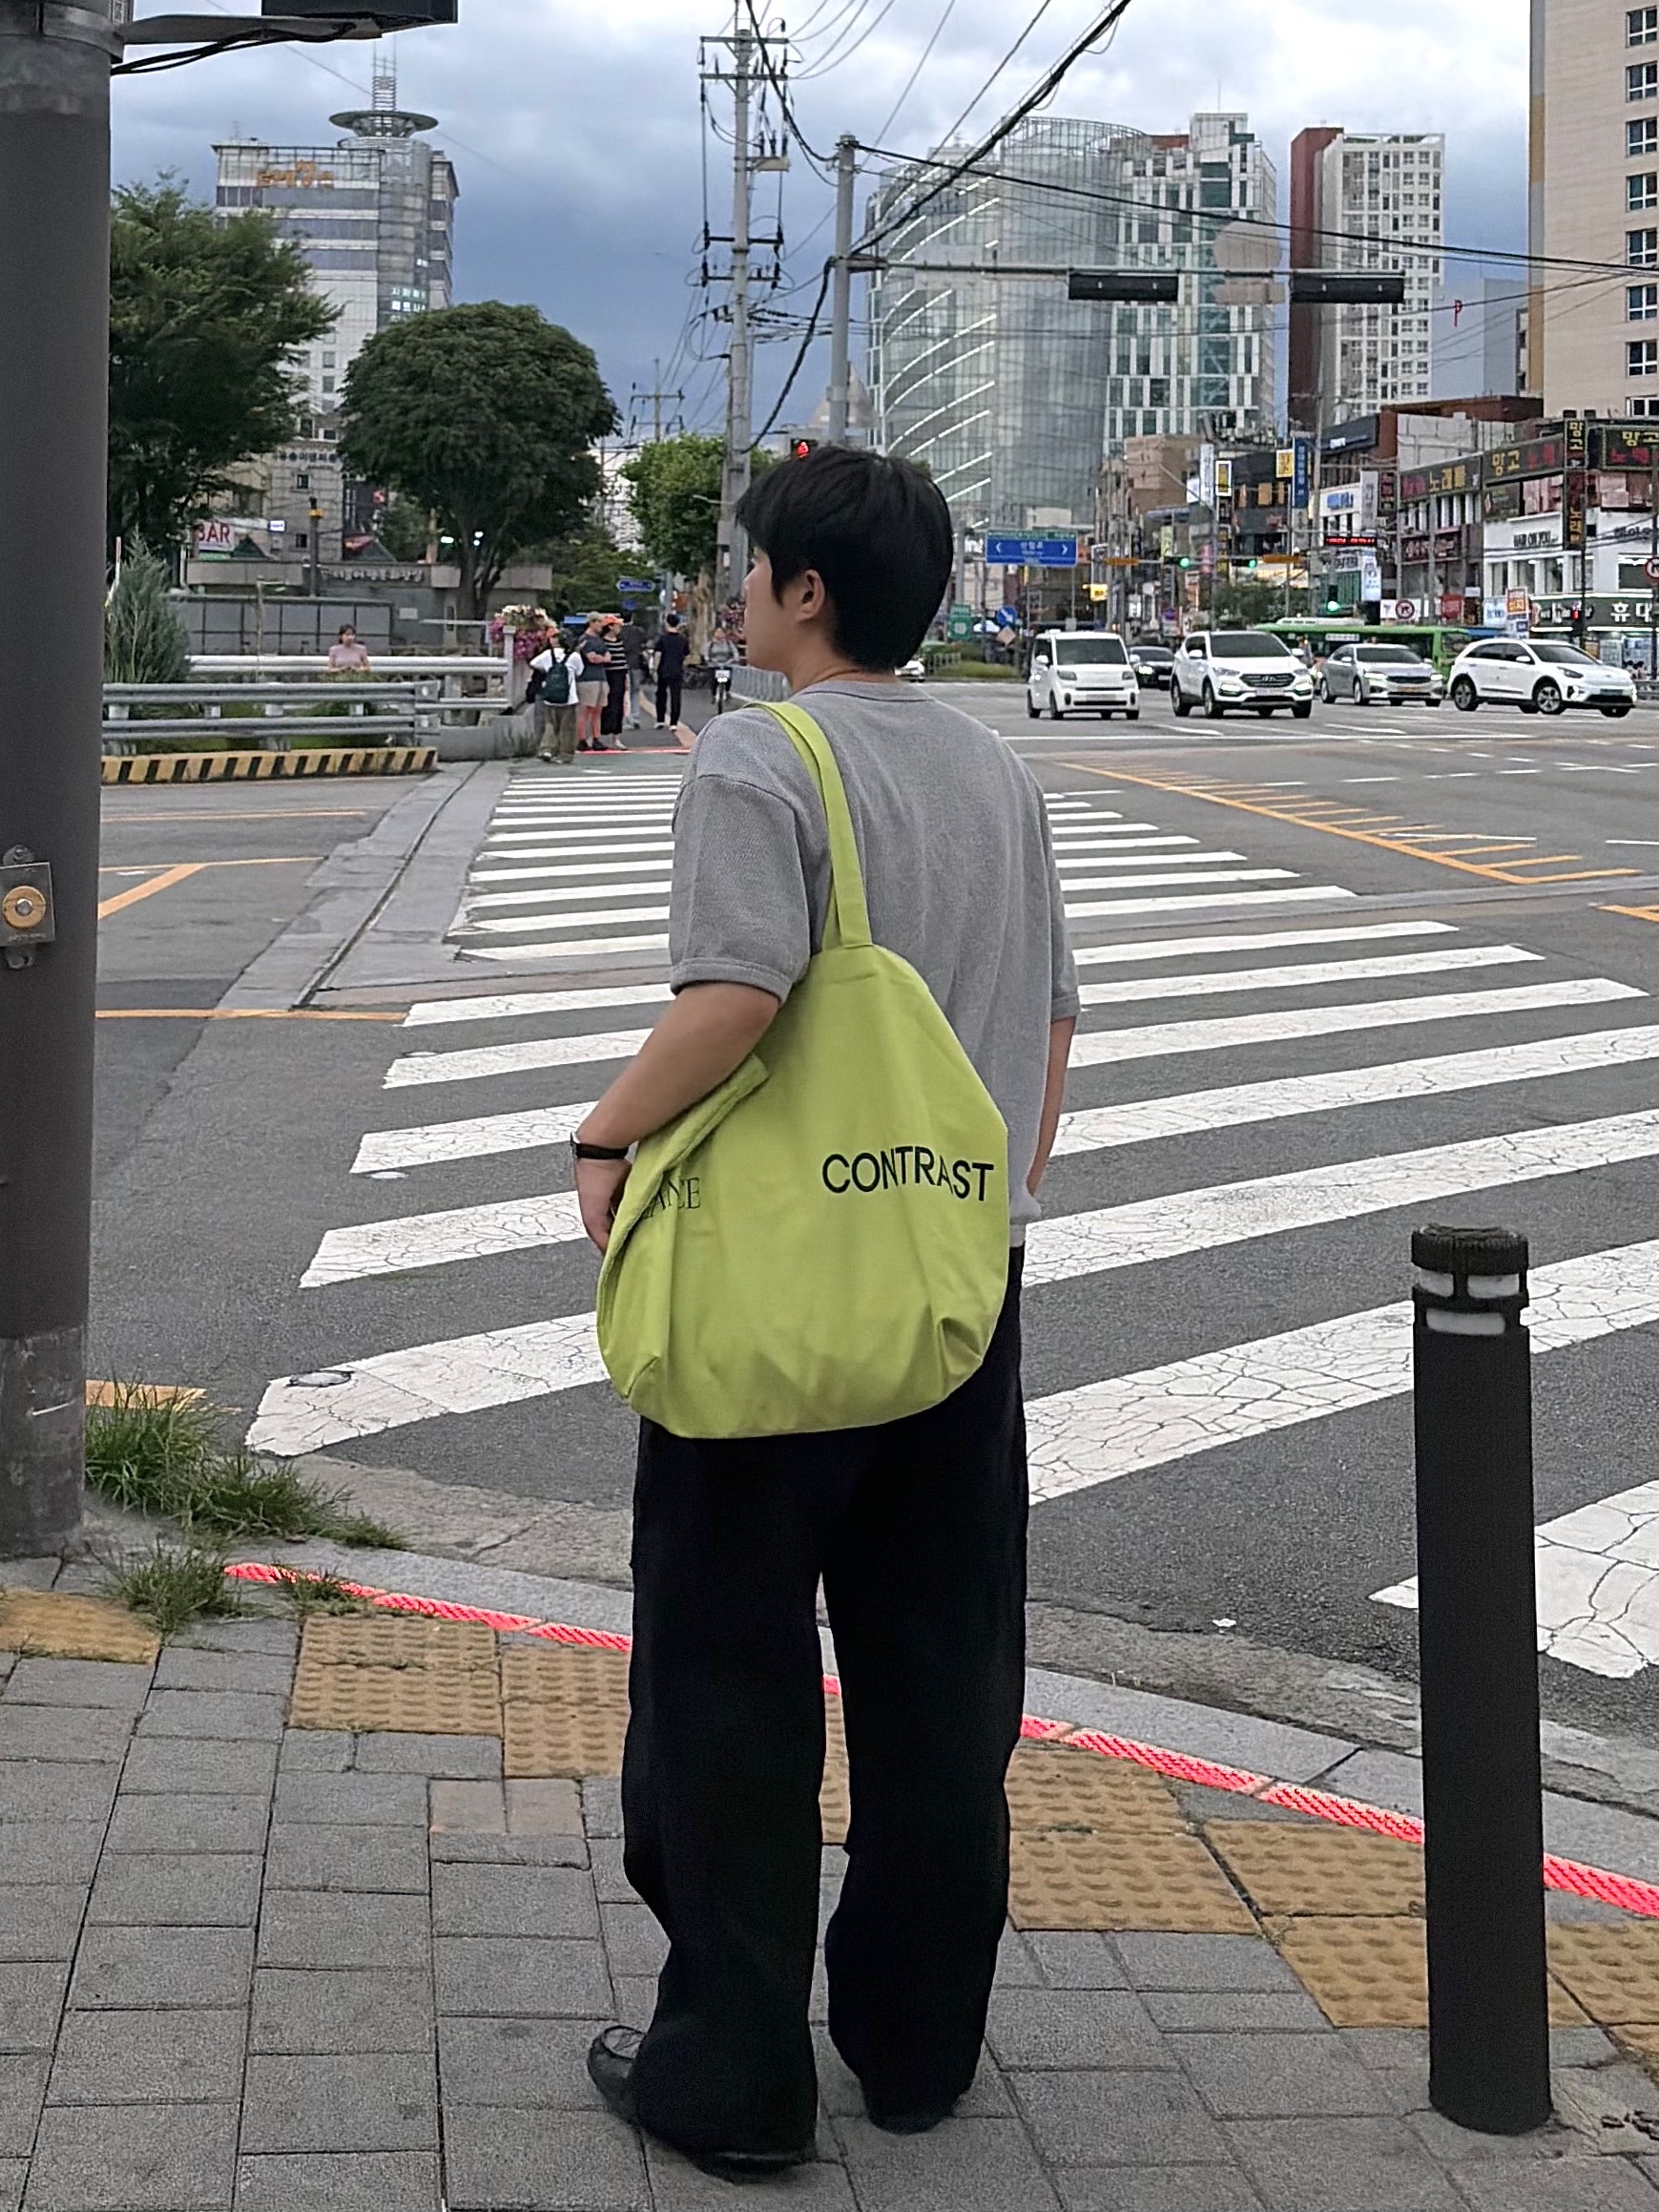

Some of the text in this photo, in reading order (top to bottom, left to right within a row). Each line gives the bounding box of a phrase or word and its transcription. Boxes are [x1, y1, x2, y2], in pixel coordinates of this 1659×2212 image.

[1569, 422, 1584, 451] 망고
[1492, 449, 1521, 476] 망고
[821, 1145, 995, 1202] CONTRAST
